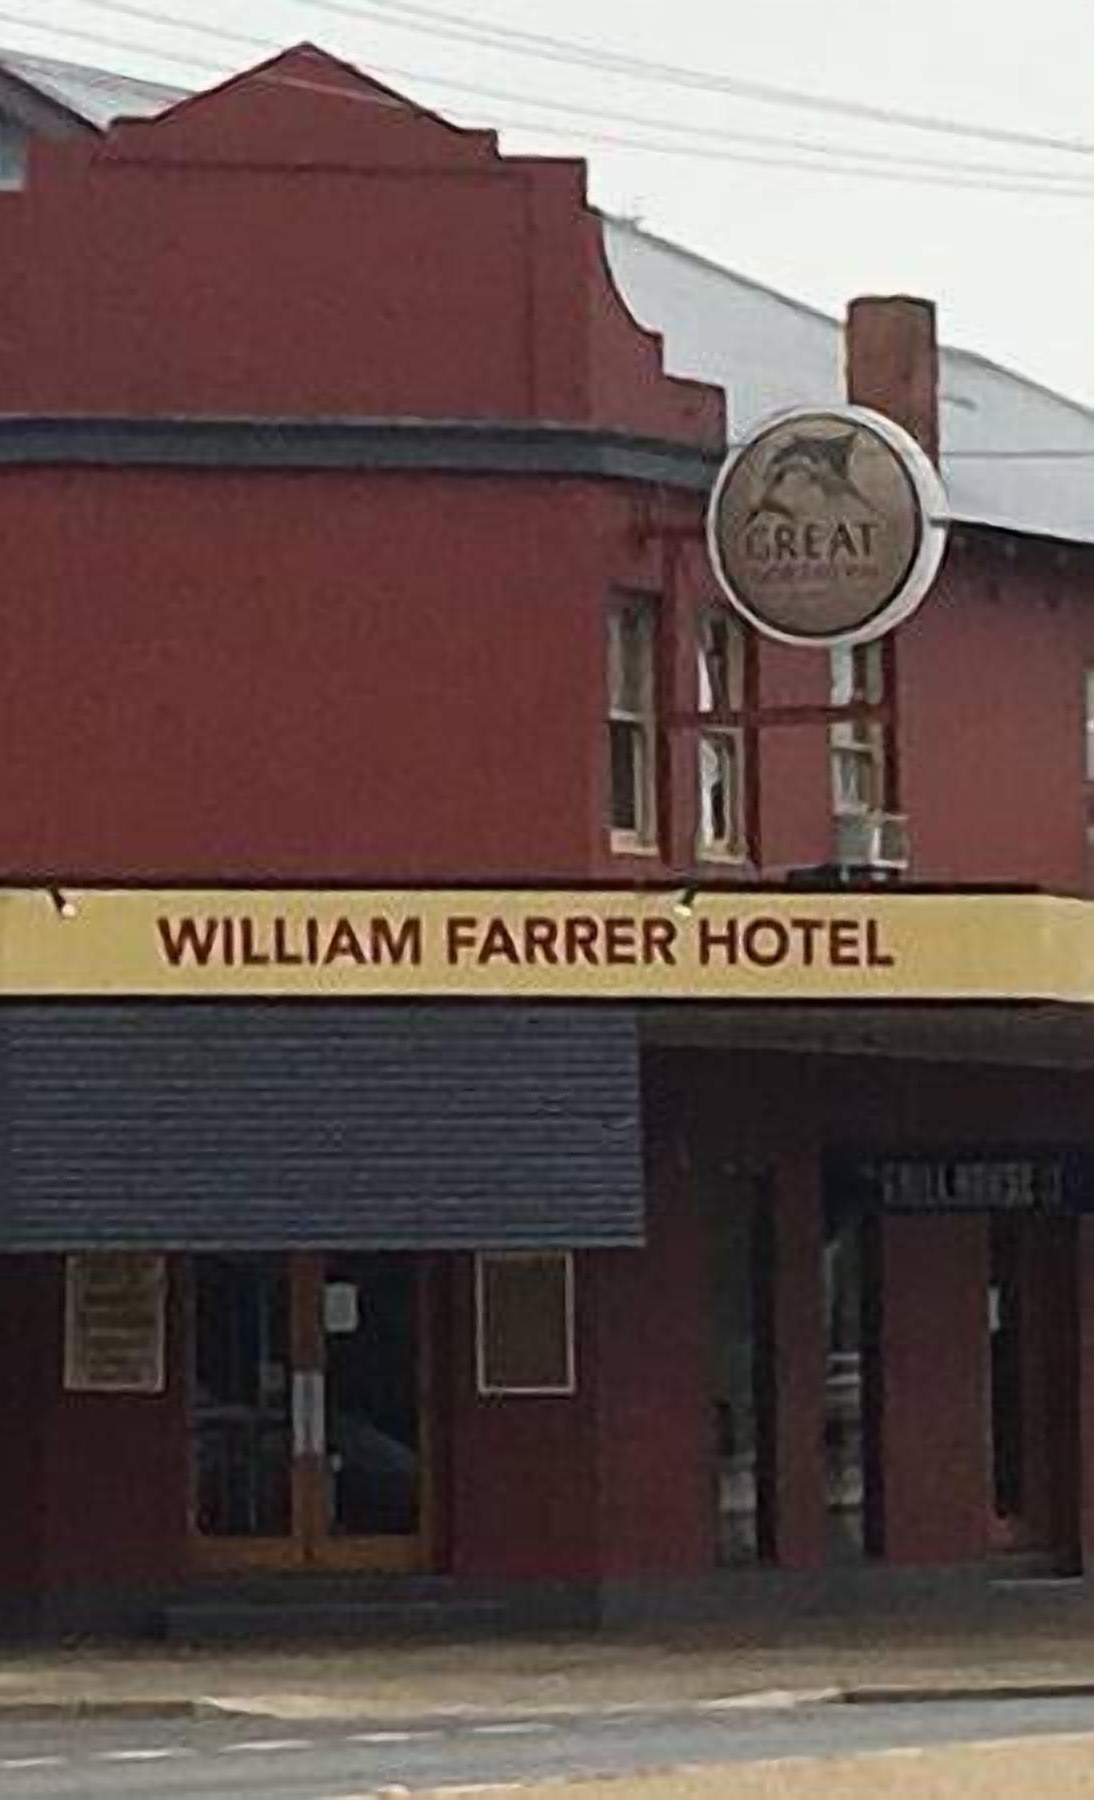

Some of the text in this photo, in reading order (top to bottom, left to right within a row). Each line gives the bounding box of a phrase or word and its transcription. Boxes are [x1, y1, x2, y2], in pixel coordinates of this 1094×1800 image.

[745, 522, 878, 562] GREAT
[157, 915, 895, 968] WILLIAM FARRER HOTEL
